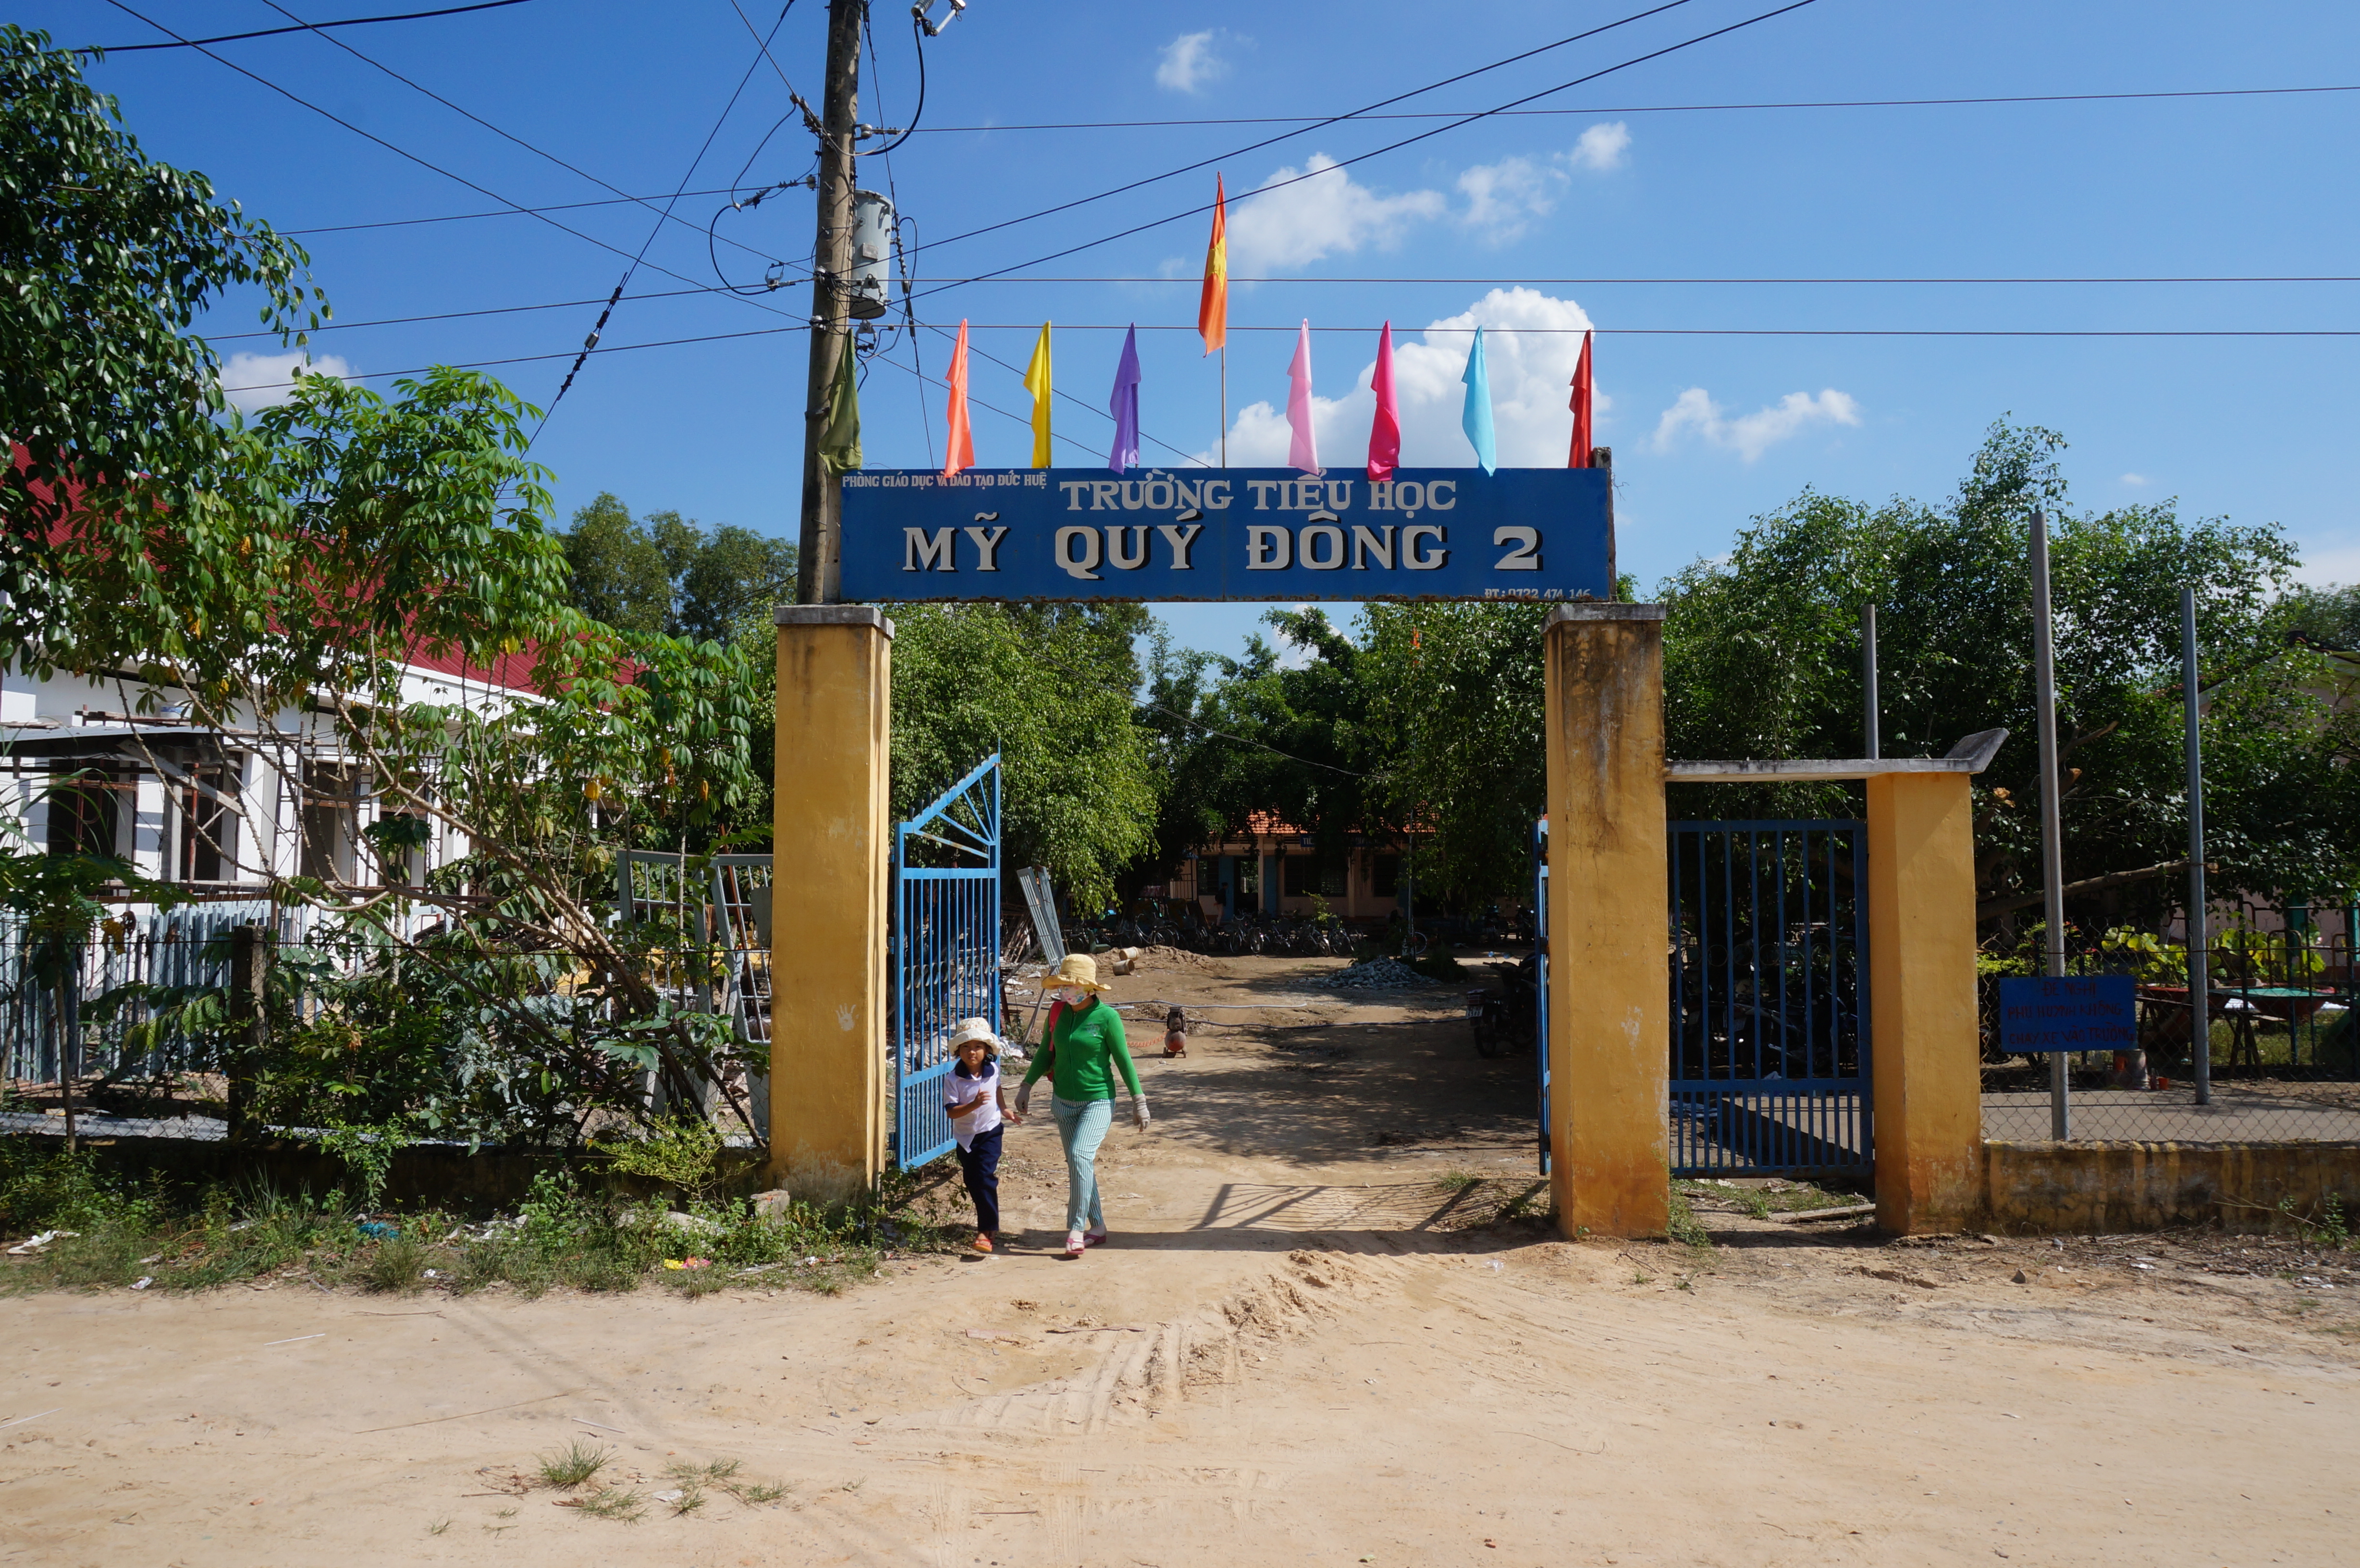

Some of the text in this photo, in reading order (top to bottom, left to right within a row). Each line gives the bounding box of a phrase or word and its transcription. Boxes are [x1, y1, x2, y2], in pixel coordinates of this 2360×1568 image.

[842, 471, 879, 487] PHÒNG
[882, 471, 909, 487] GIÁO
[911, 475, 934, 490] DỤC
[936, 471, 947, 486] VÀ
[974, 475, 994, 490] TẠO
[997, 470, 1020, 486] ĐỨC
[1024, 472, 1046, 489] HUỆ
[1059, 468, 1456, 519] TRƯỜNG TIỂU HỌC
[902, 509, 1543, 580] MỸ QUÝ ĐÔNG 2
[2041, 1031, 2059, 1044] XE
